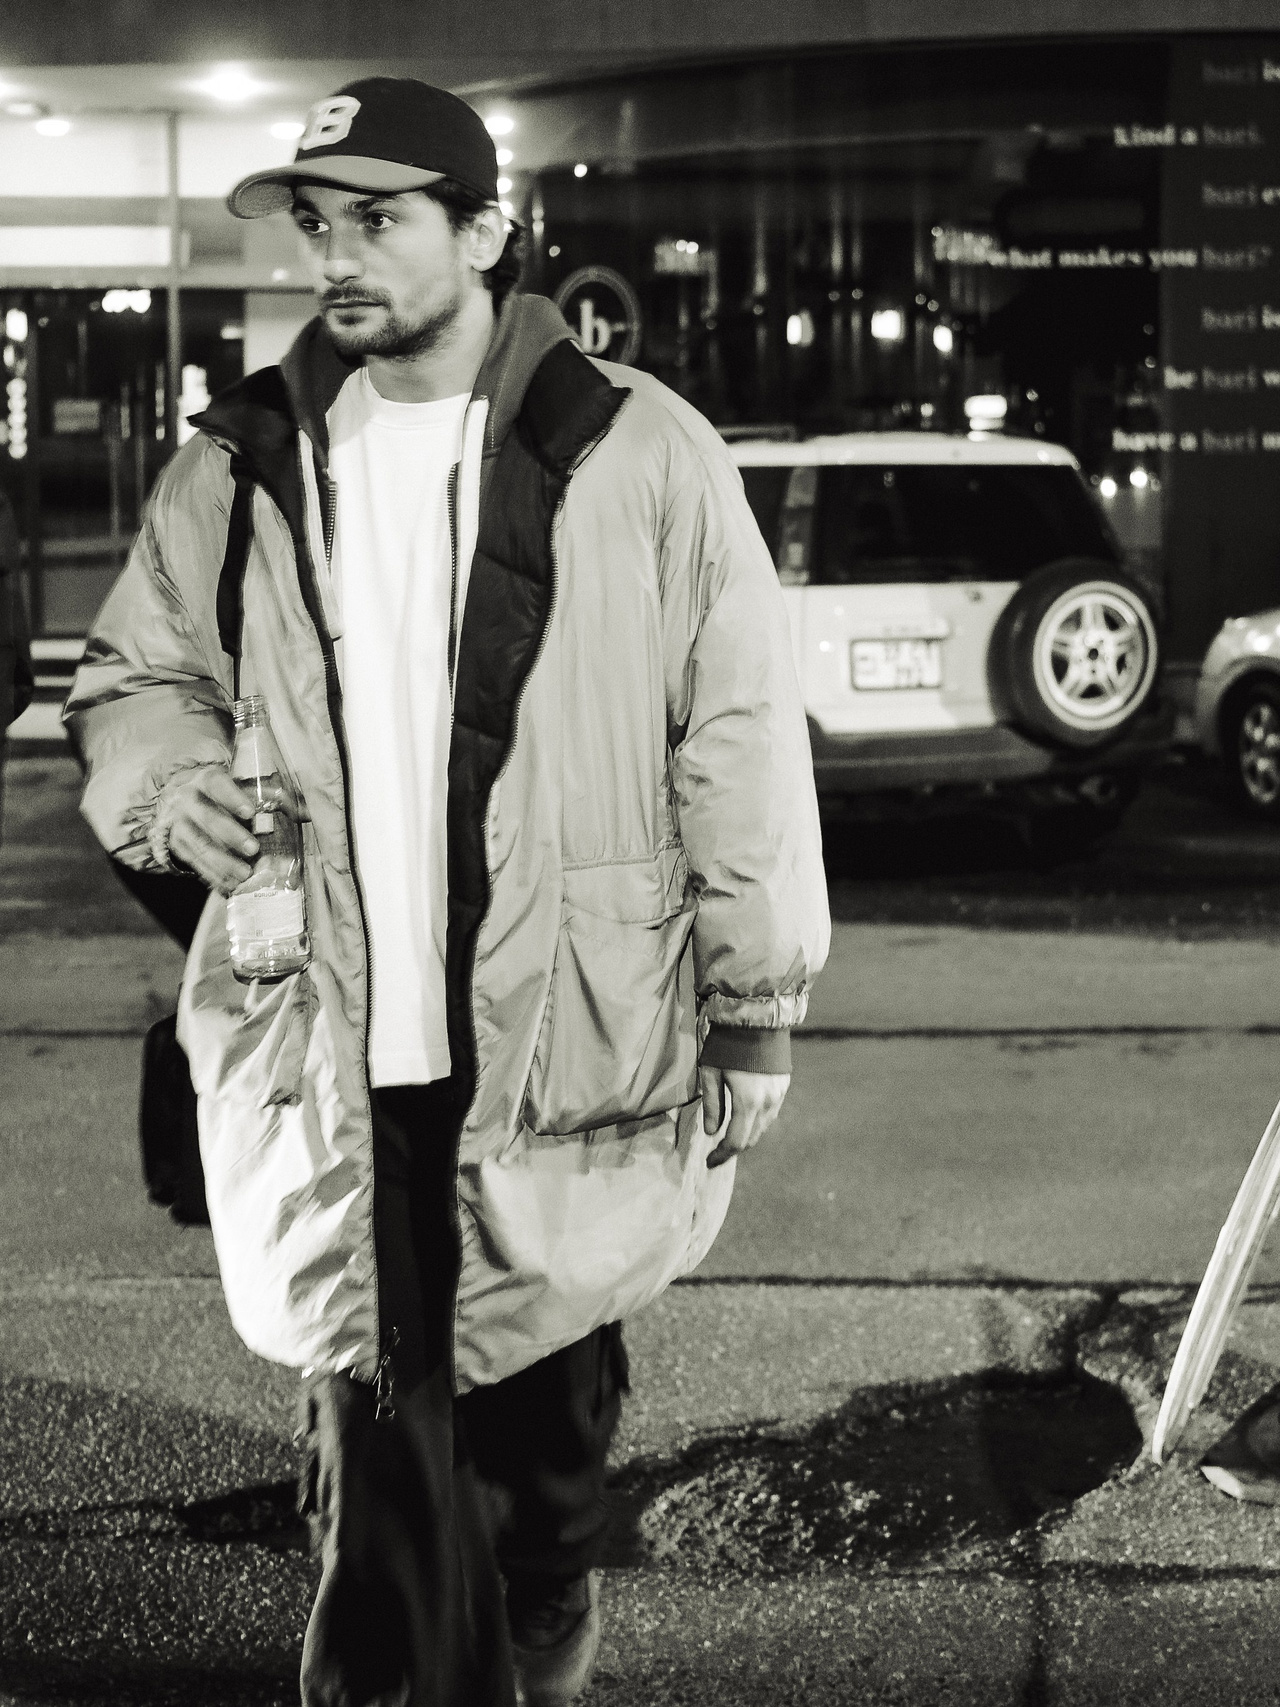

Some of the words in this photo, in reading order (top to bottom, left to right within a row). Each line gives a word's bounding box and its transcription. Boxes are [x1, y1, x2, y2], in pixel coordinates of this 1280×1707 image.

[302, 95, 361, 151] B
[1058, 244, 1144, 268] makes
[1148, 248, 1199, 272] you
[1164, 365, 1199, 390] be
[1112, 428, 1175, 453] have
[1179, 431, 1198, 452] a
